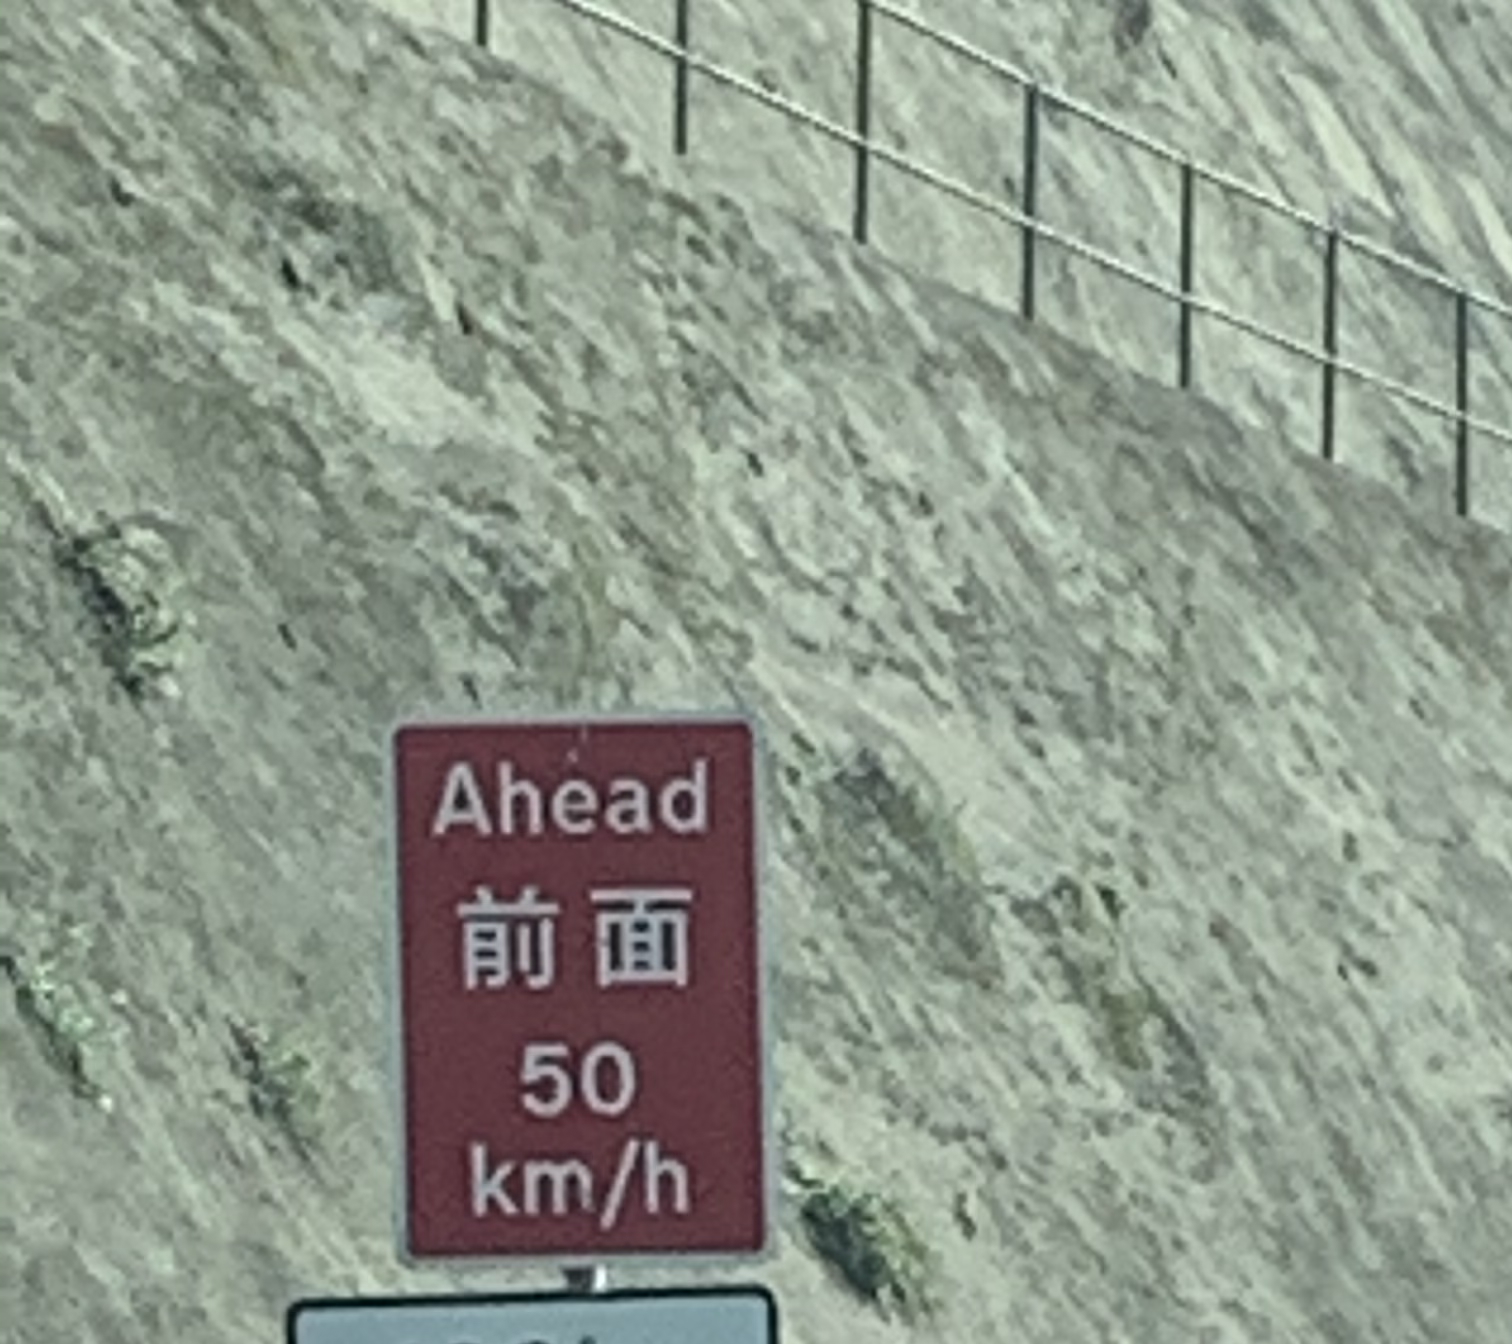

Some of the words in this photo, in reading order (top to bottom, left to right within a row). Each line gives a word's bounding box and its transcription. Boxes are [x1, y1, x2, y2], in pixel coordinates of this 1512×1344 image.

[433, 758, 708, 835] Ahead
[456, 885, 694, 990] 前面
[520, 1040, 637, 1118] 50
[471, 1138, 690, 1230] km/h
